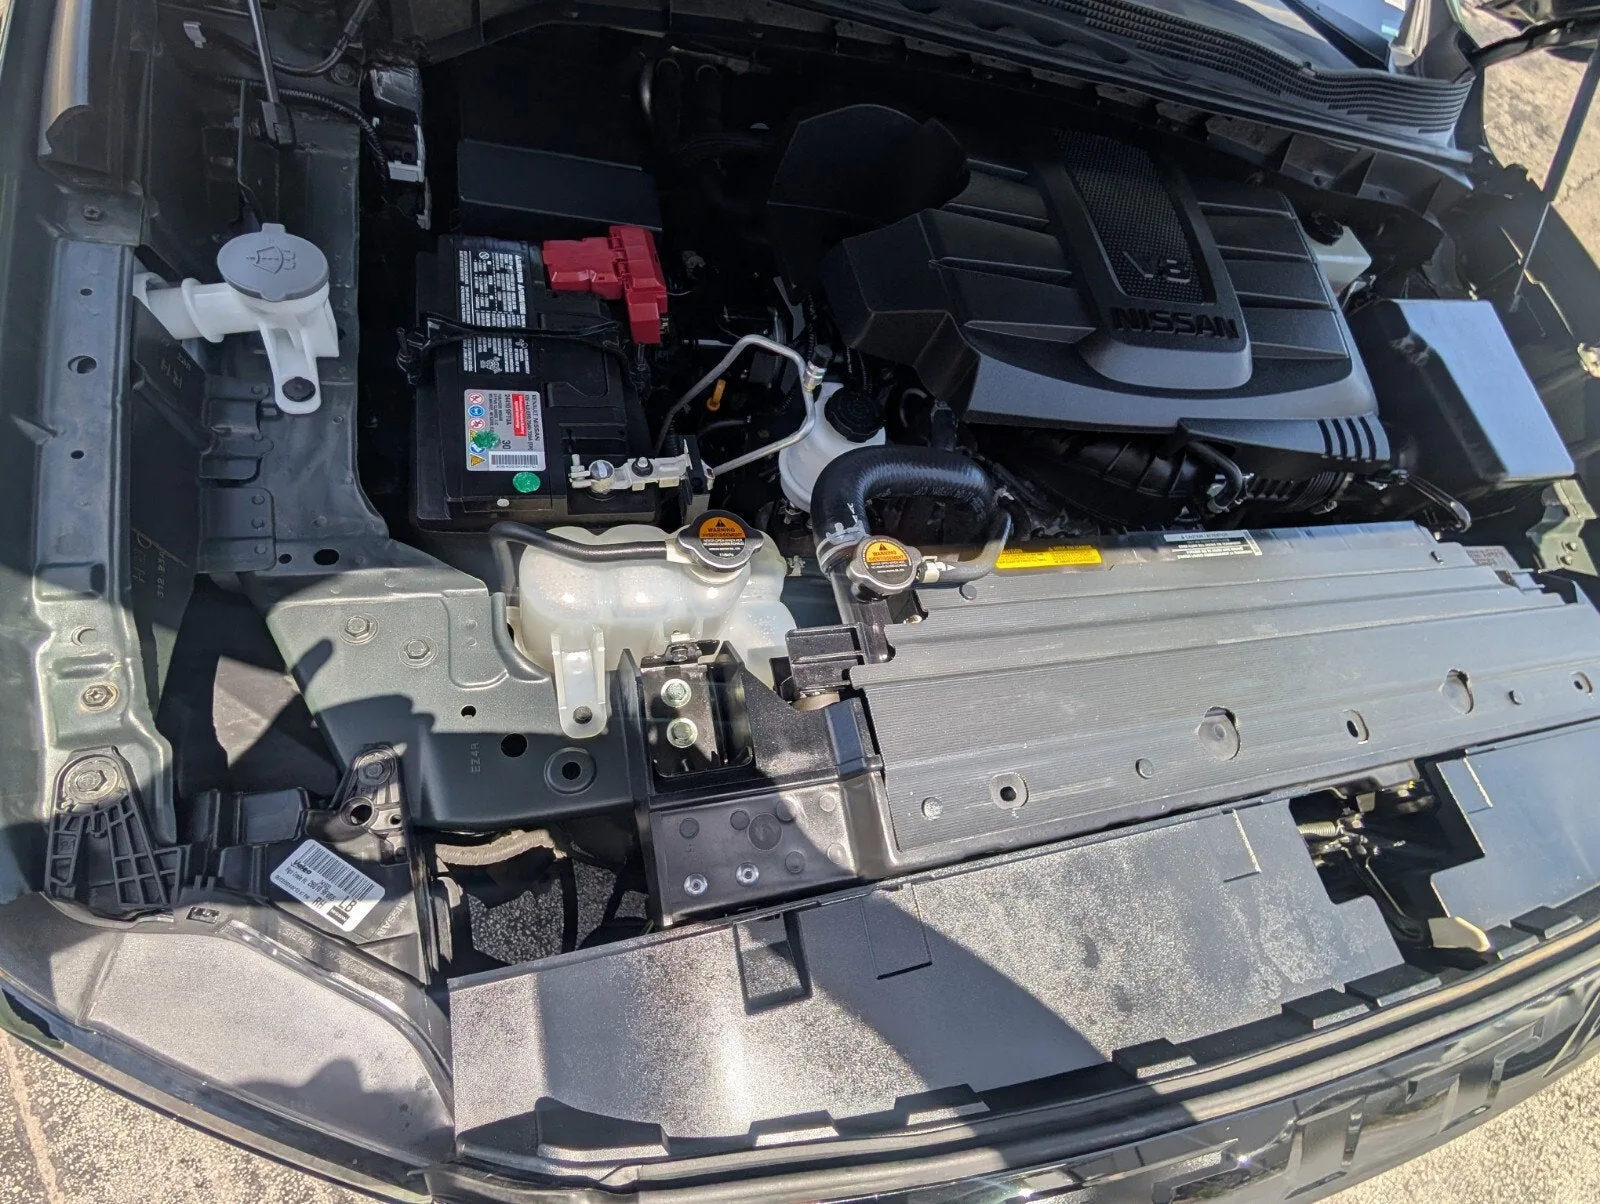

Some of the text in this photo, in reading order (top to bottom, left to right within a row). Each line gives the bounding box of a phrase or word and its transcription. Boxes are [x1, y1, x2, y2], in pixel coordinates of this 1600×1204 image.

[1109, 306, 1240, 339] NISSAN
[502, 440, 511, 450] 30
[312, 896, 327, 909] RH
[339, 895, 358, 912] LB
[375, 900, 409, 937] NISSAN
